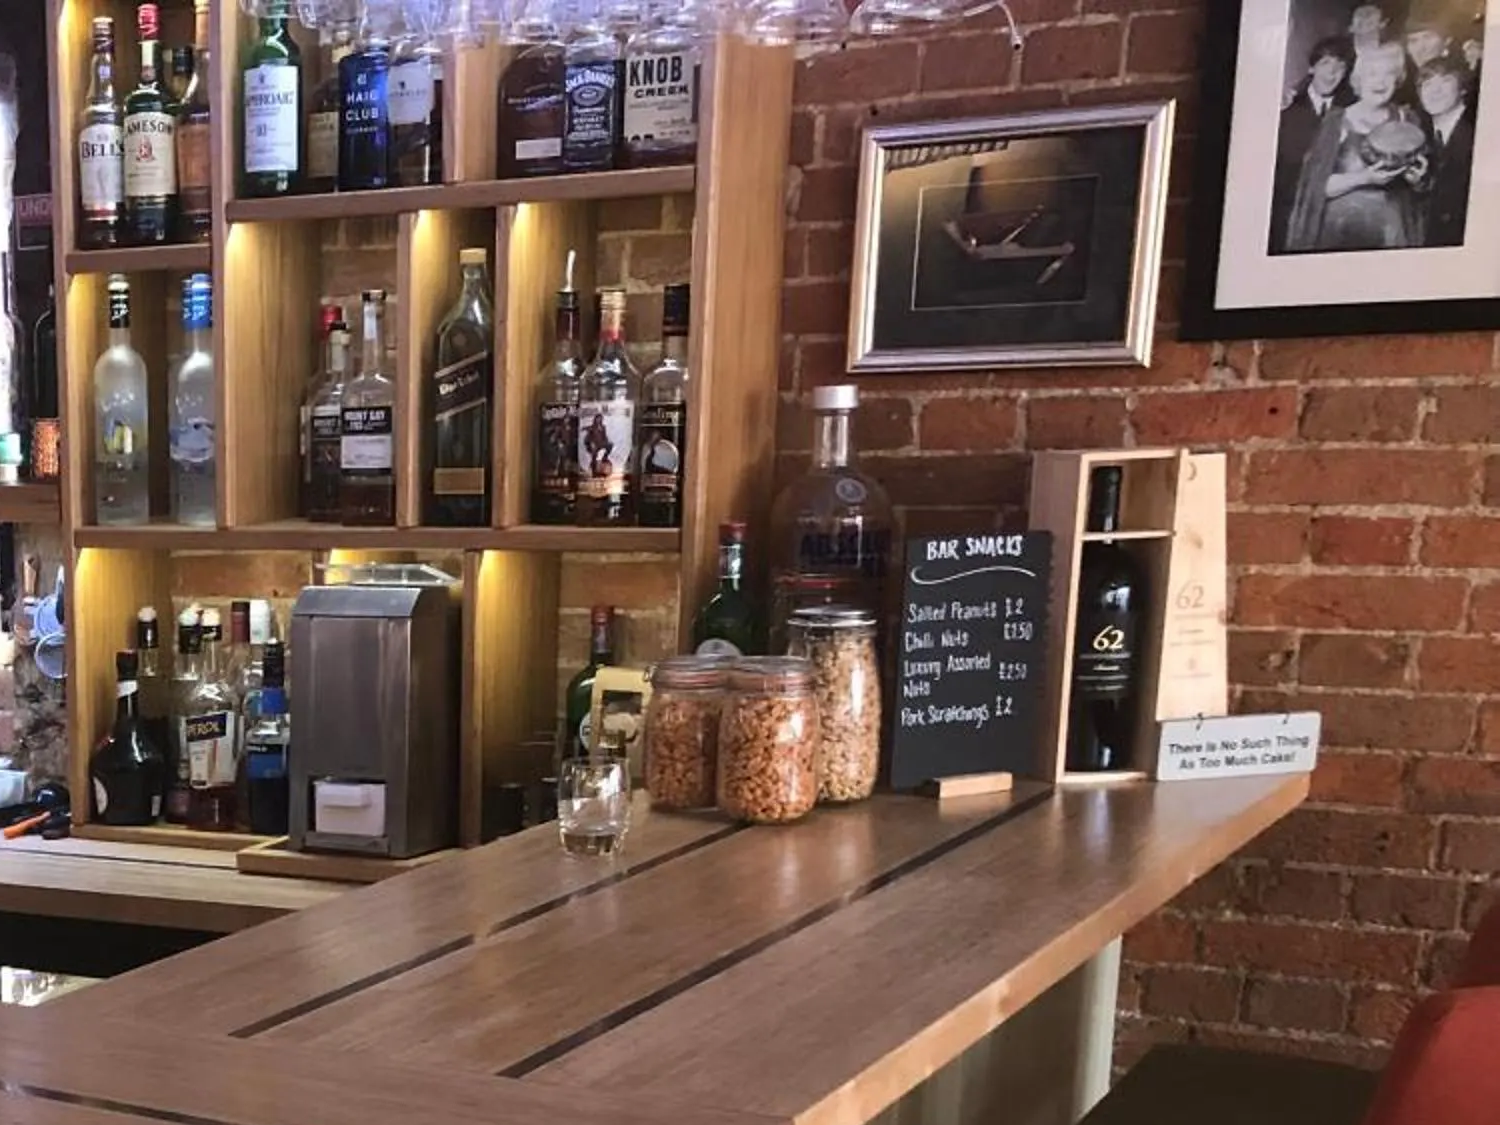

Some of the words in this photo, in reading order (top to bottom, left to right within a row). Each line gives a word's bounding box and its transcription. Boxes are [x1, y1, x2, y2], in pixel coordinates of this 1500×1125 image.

[629, 56, 682, 86] KNOB
[634, 85, 689, 99] CREEK
[345, 108, 379, 121] CLUB
[926, 539, 960, 560] BAR
[965, 535, 1023, 557] SNACKS
[1175, 580, 1205, 609] 62
[908, 602, 947, 624] Salted
[951, 601, 997, 620] Peanuts
[941, 630, 969, 647] Nuts
[1093, 625, 1125, 650] 62
[946, 652, 991, 672] Assorted
[903, 680, 931, 698] Nuts
[901, 707, 926, 726] Pork
[1169, 743, 1202, 755] There
[1220, 740, 1237, 751] No
[1241, 737, 1271, 750] Such
[1276, 735, 1309, 749] Thing
[1179, 759, 1195, 769] As
[1200, 757, 1221, 768] Too
[1224, 754, 1257, 766] Much
